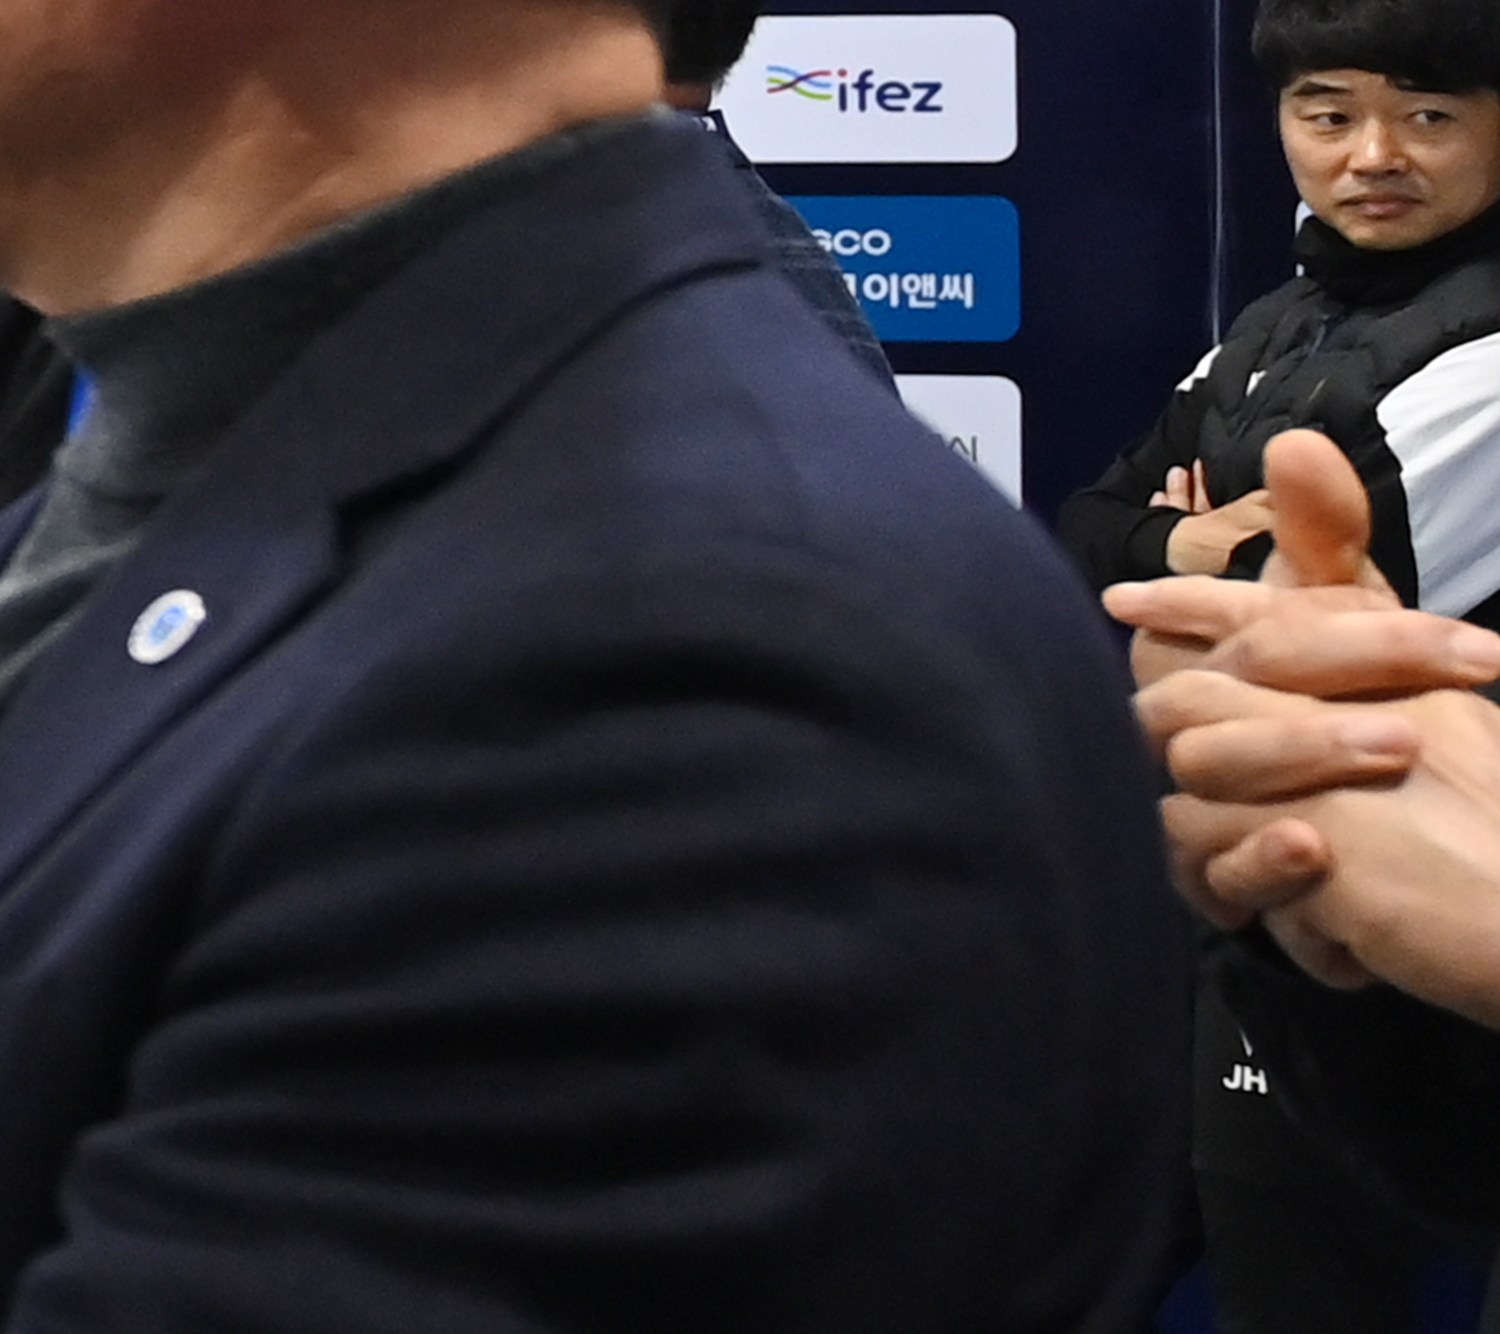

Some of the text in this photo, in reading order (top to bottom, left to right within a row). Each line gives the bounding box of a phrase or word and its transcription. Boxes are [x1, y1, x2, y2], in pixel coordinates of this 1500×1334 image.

[837, 69, 944, 113] ifez
[811, 228, 892, 257] sco
[843, 272, 975, 310] 이앤씨
[1222, 1063, 1268, 1095] JH
